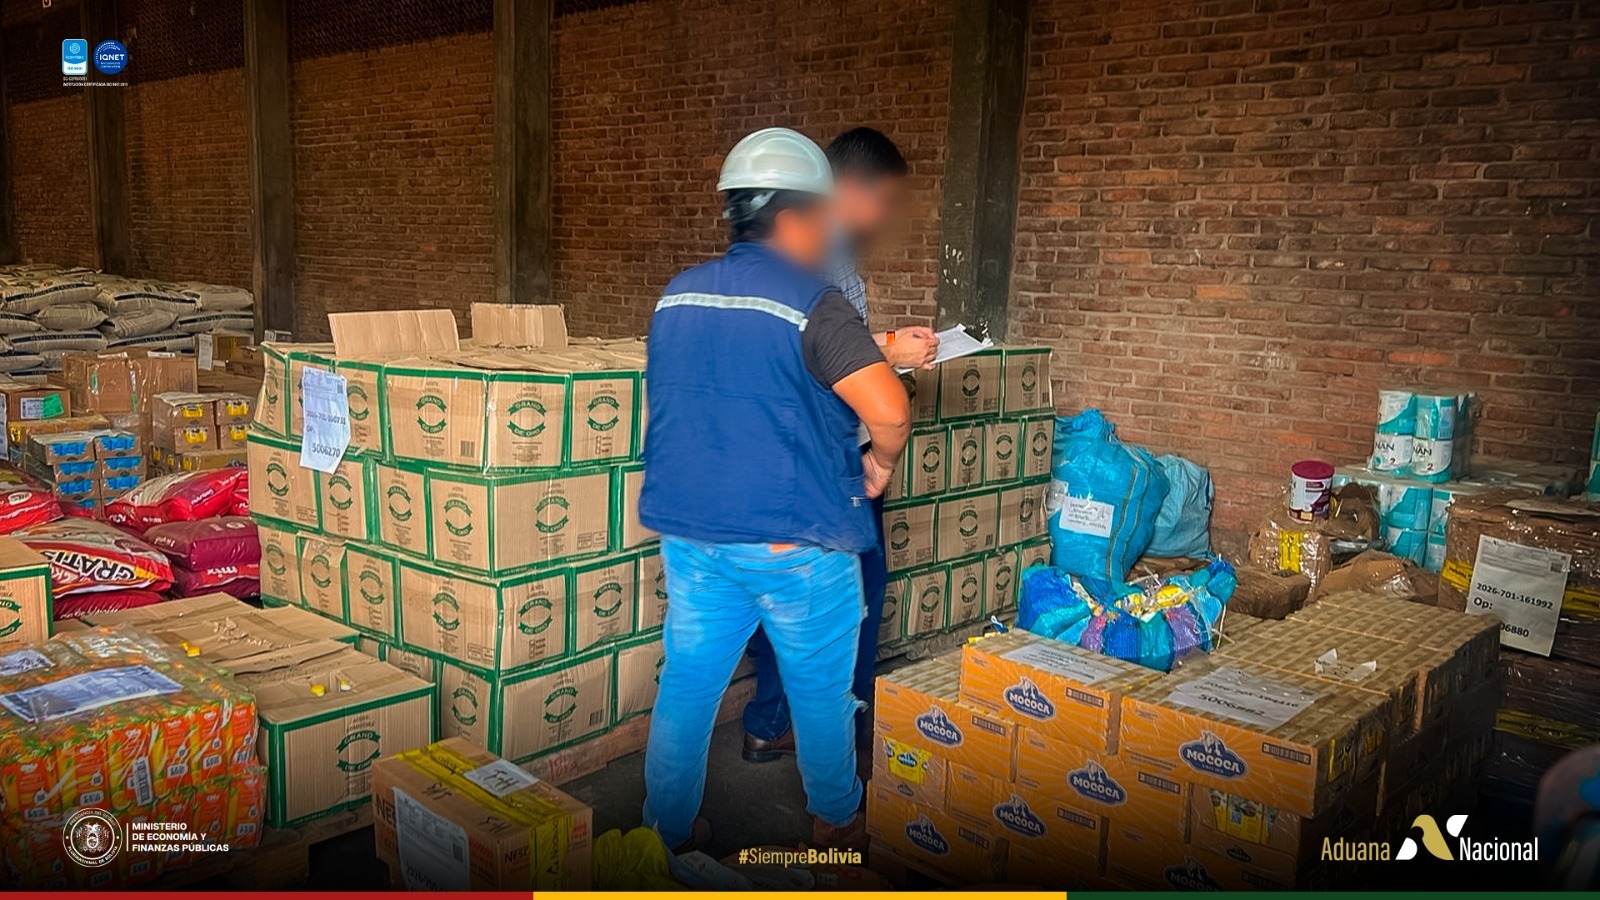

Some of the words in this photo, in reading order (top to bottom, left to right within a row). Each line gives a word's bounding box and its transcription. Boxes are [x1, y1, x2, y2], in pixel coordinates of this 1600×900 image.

[1473, 597, 1493, 609] Op:
[1476, 582, 1554, 610] 2026-701-161992
[1500, 622, 1529, 637] 06880
[1009, 692, 1051, 716] MOCOCA
[920, 719, 959, 742] MOCOCA
[1186, 748, 1240, 774] MOCOCA
[1073, 776, 1121, 800] MOCOCA
[1000, 809, 1042, 835] MOCOCA
[909, 827, 946, 852] MOCOCA
